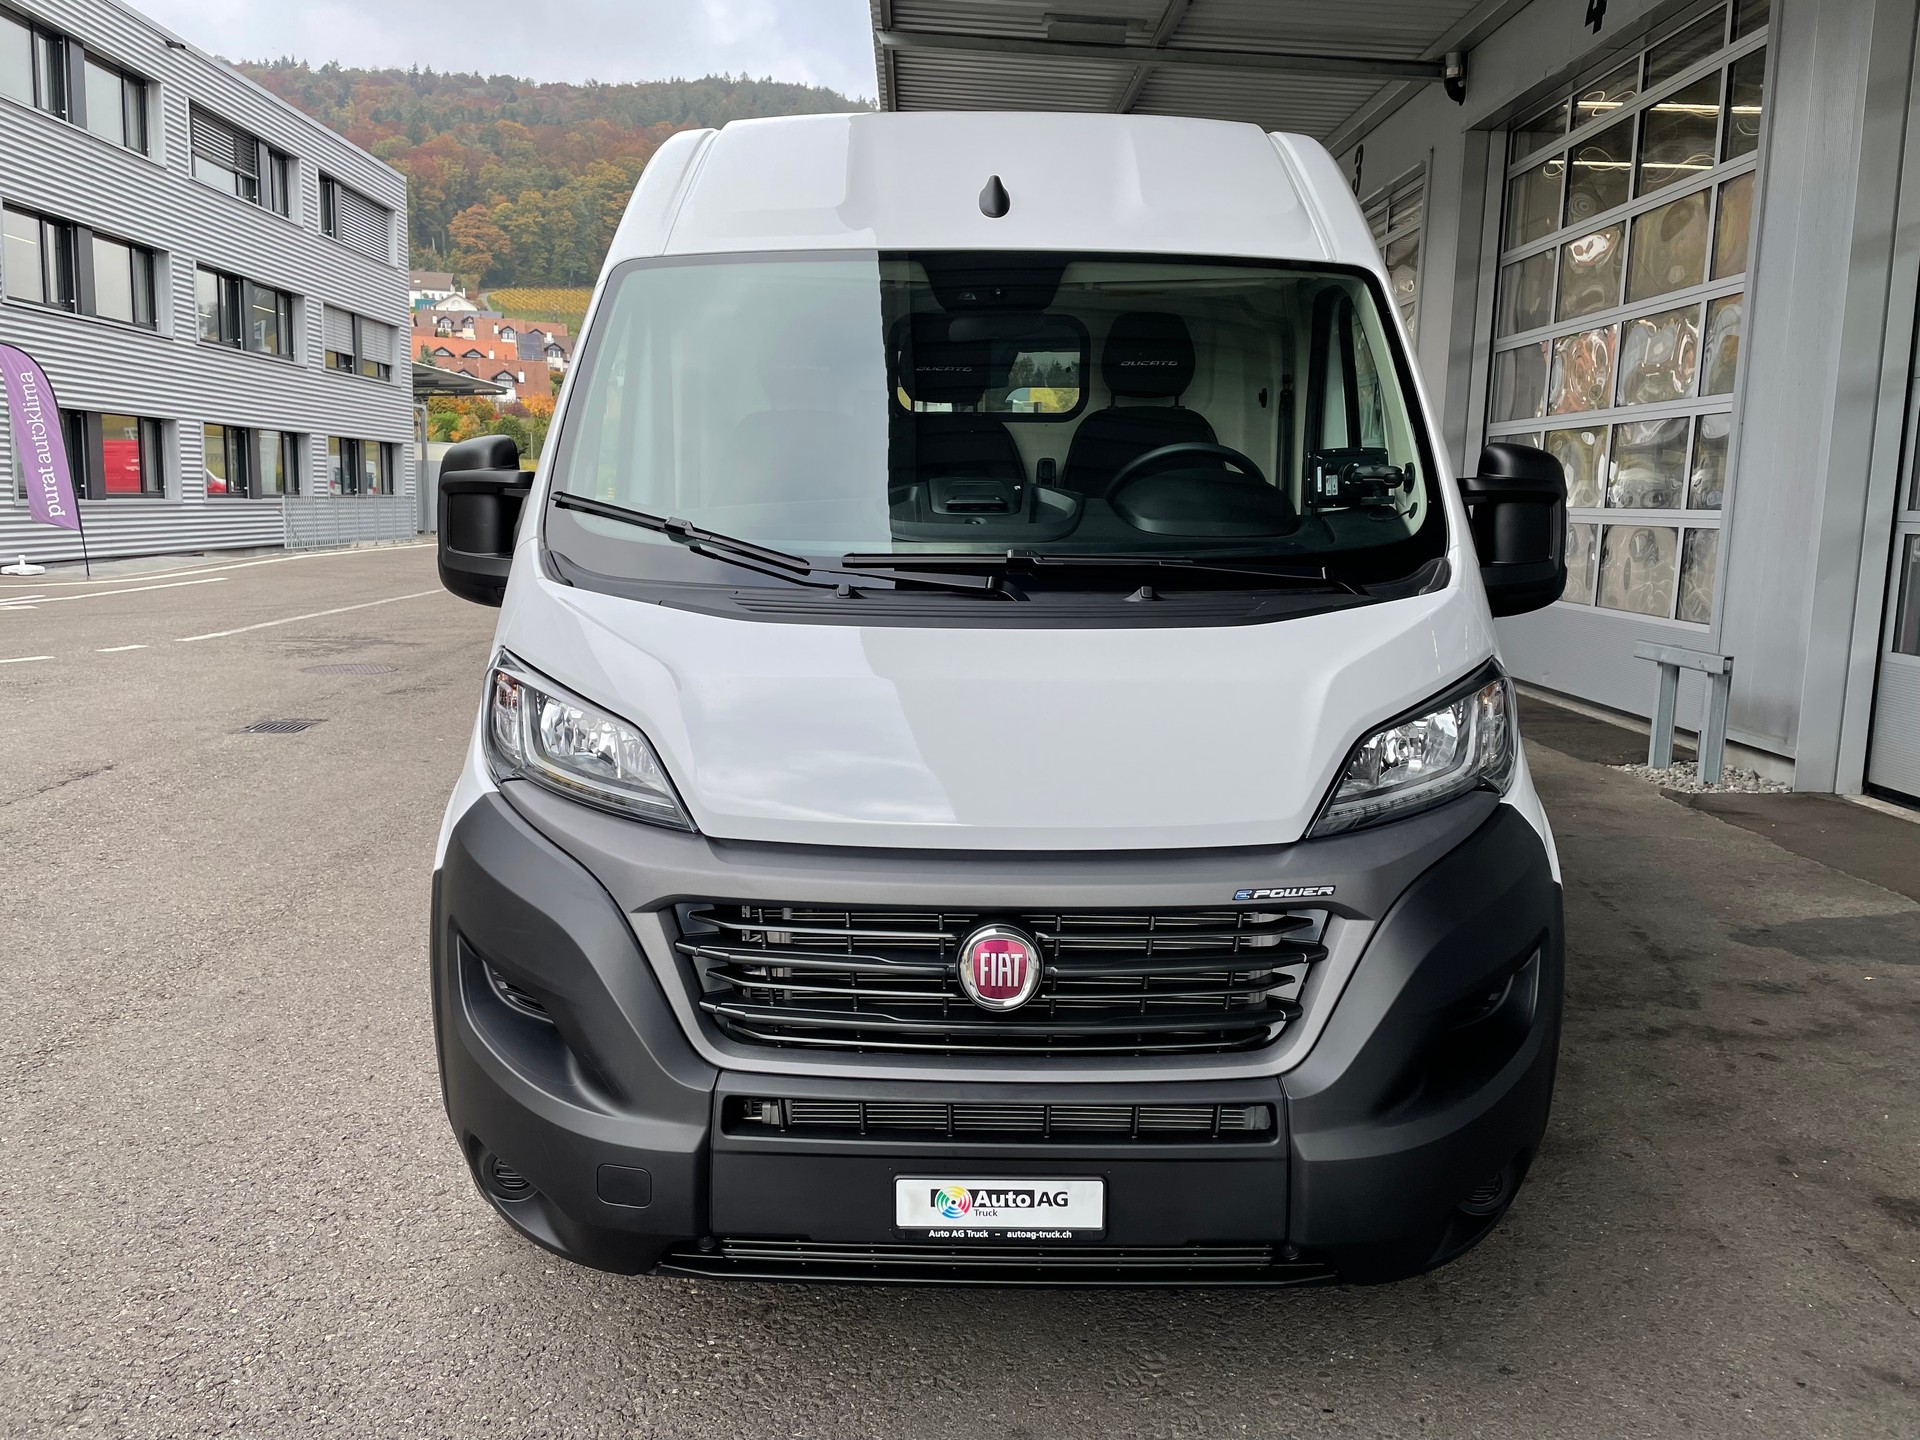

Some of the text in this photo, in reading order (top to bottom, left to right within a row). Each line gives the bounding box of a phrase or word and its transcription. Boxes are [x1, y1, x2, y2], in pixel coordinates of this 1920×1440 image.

[1351, 144, 1364, 197] 3
[38, 465, 66, 517] purat
[980, 952, 1023, 987] FIAT
[974, 1190, 1069, 1208] Auto AG
[973, 1208, 998, 1217] Truck
[928, 1230, 950, 1238] Auto
[951, 1230, 965, 1238] AG
[966, 1229, 989, 1238] Truck
[1006, 1230, 1072, 1239] autoag-truck.ch
